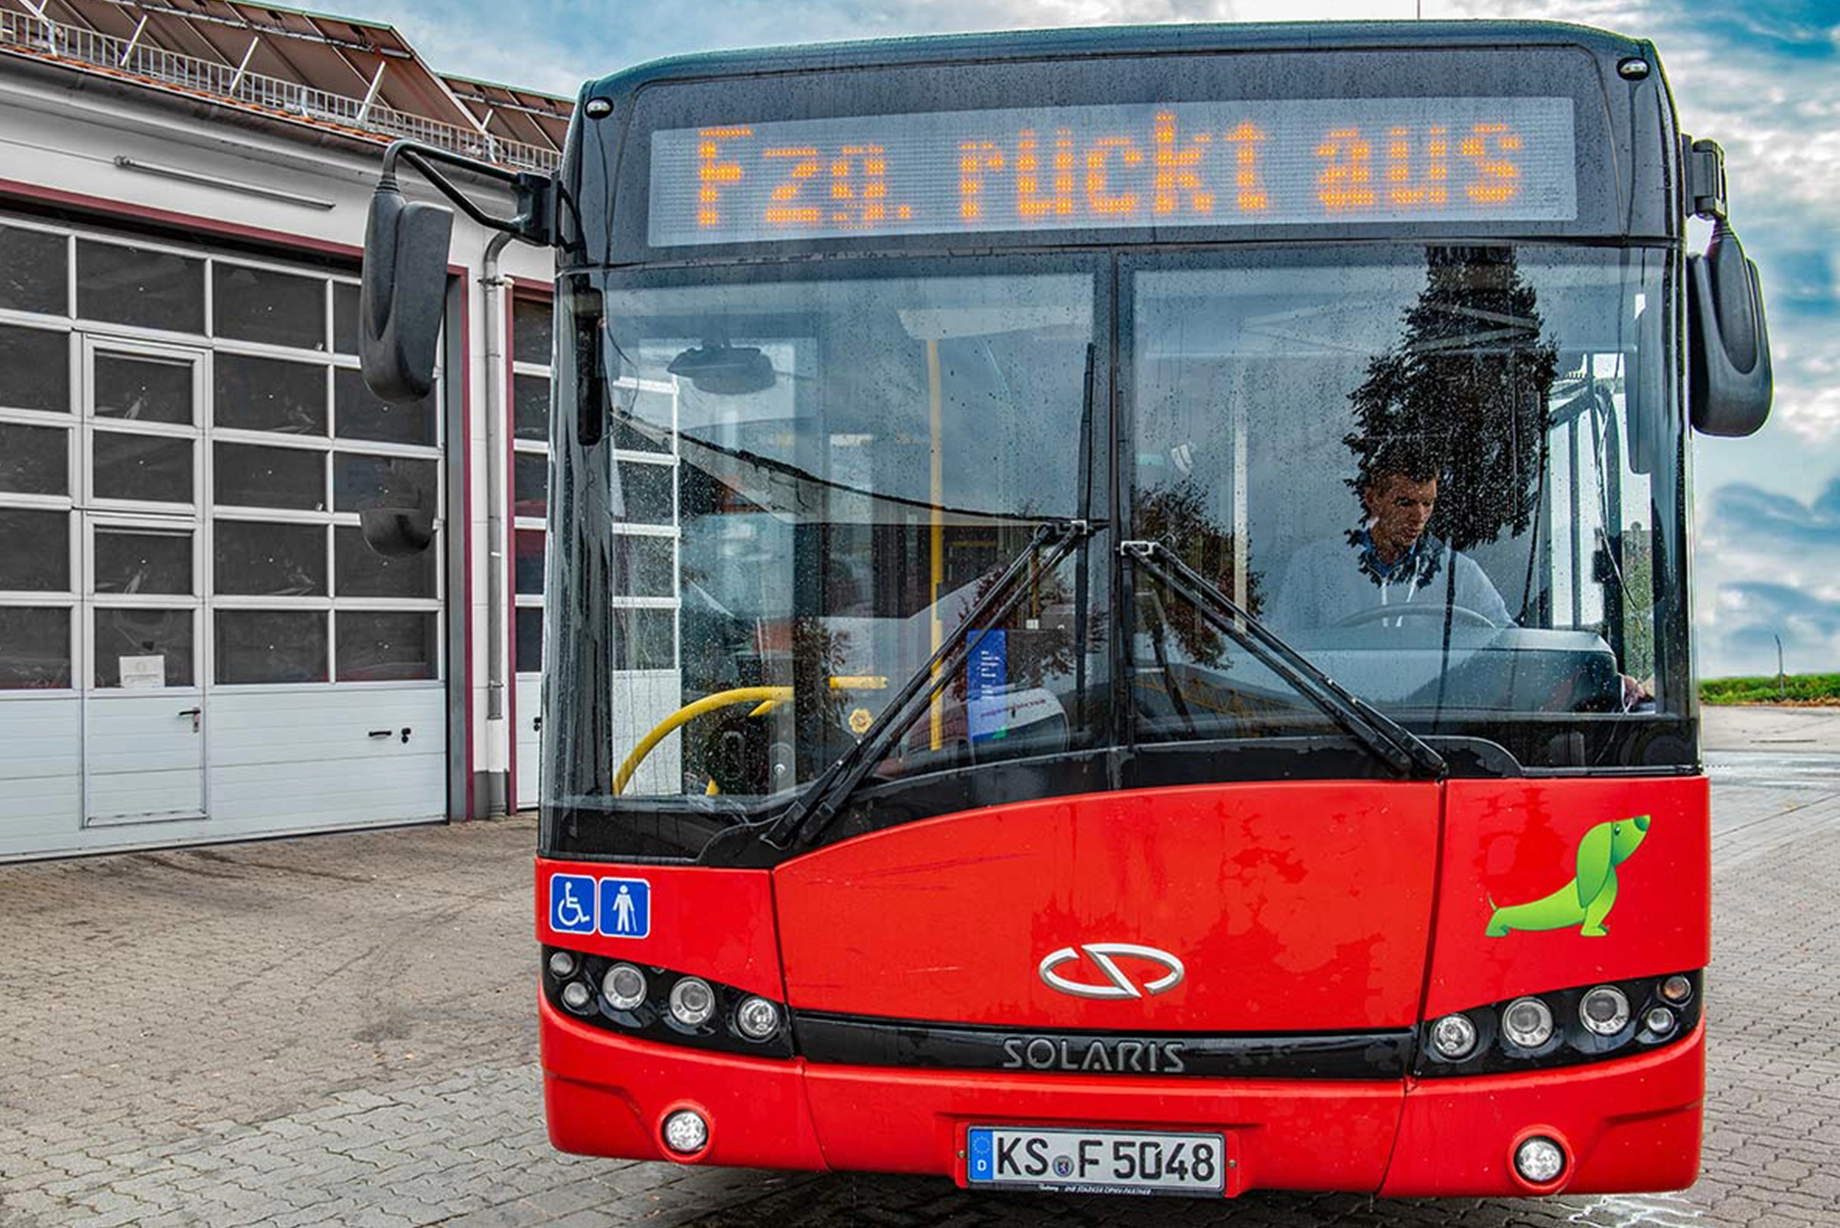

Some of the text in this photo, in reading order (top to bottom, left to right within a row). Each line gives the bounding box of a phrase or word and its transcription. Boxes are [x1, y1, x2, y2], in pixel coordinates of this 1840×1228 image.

[698, 111, 1520, 226] Fzg. rückt aus
[1003, 1038, 1185, 1072] SOLARIS
[997, 1137, 1215, 1181] KS F 5048
